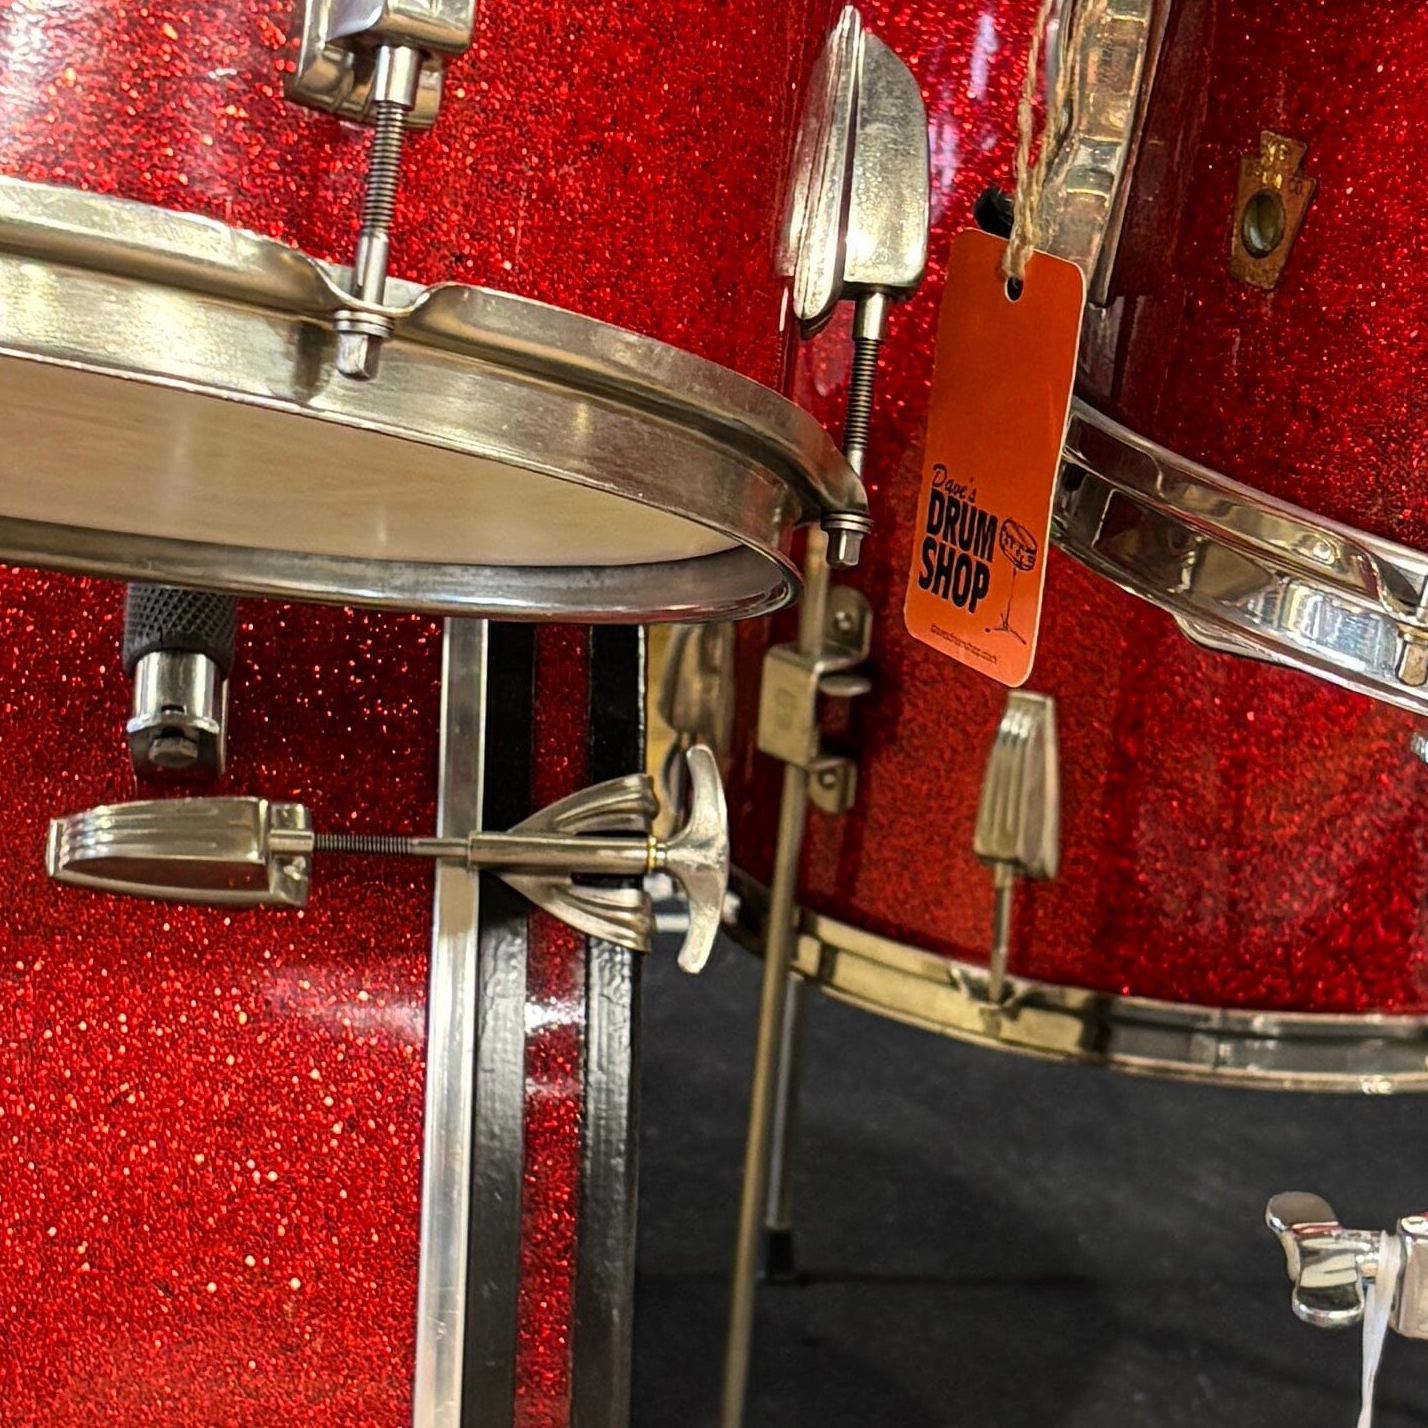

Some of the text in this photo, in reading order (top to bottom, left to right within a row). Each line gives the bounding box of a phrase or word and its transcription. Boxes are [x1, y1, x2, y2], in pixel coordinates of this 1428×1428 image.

[932, 463, 977, 503] Dave's
[926, 487, 999, 563] DRUM
[918, 536, 991, 614] SHOP
